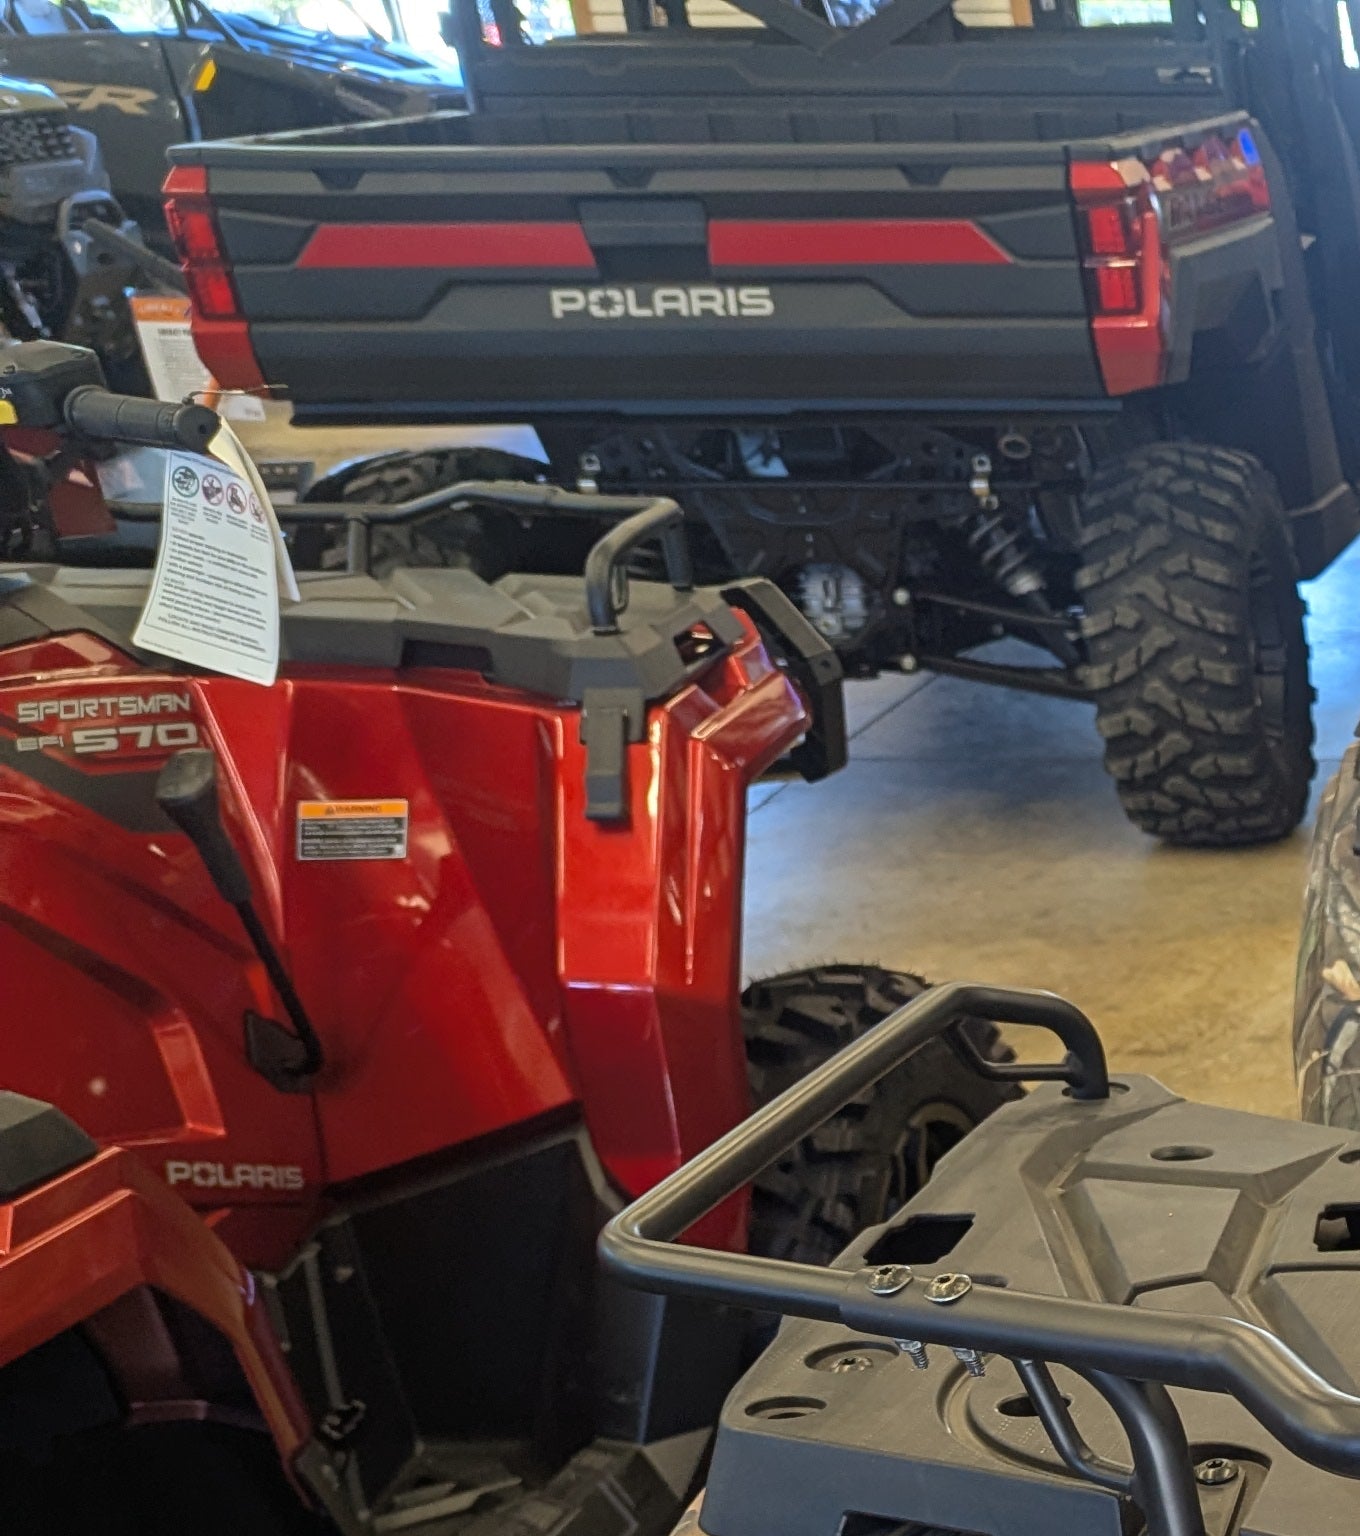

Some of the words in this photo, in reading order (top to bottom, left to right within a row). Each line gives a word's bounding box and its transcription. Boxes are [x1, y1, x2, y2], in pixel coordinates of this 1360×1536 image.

[551, 286, 775, 317] POLARIS
[17, 694, 191, 723] SPORTSMAN
[16, 735, 65, 752] EFI
[74, 722, 198, 754] 570
[167, 1161, 304, 1189] POLARIS
